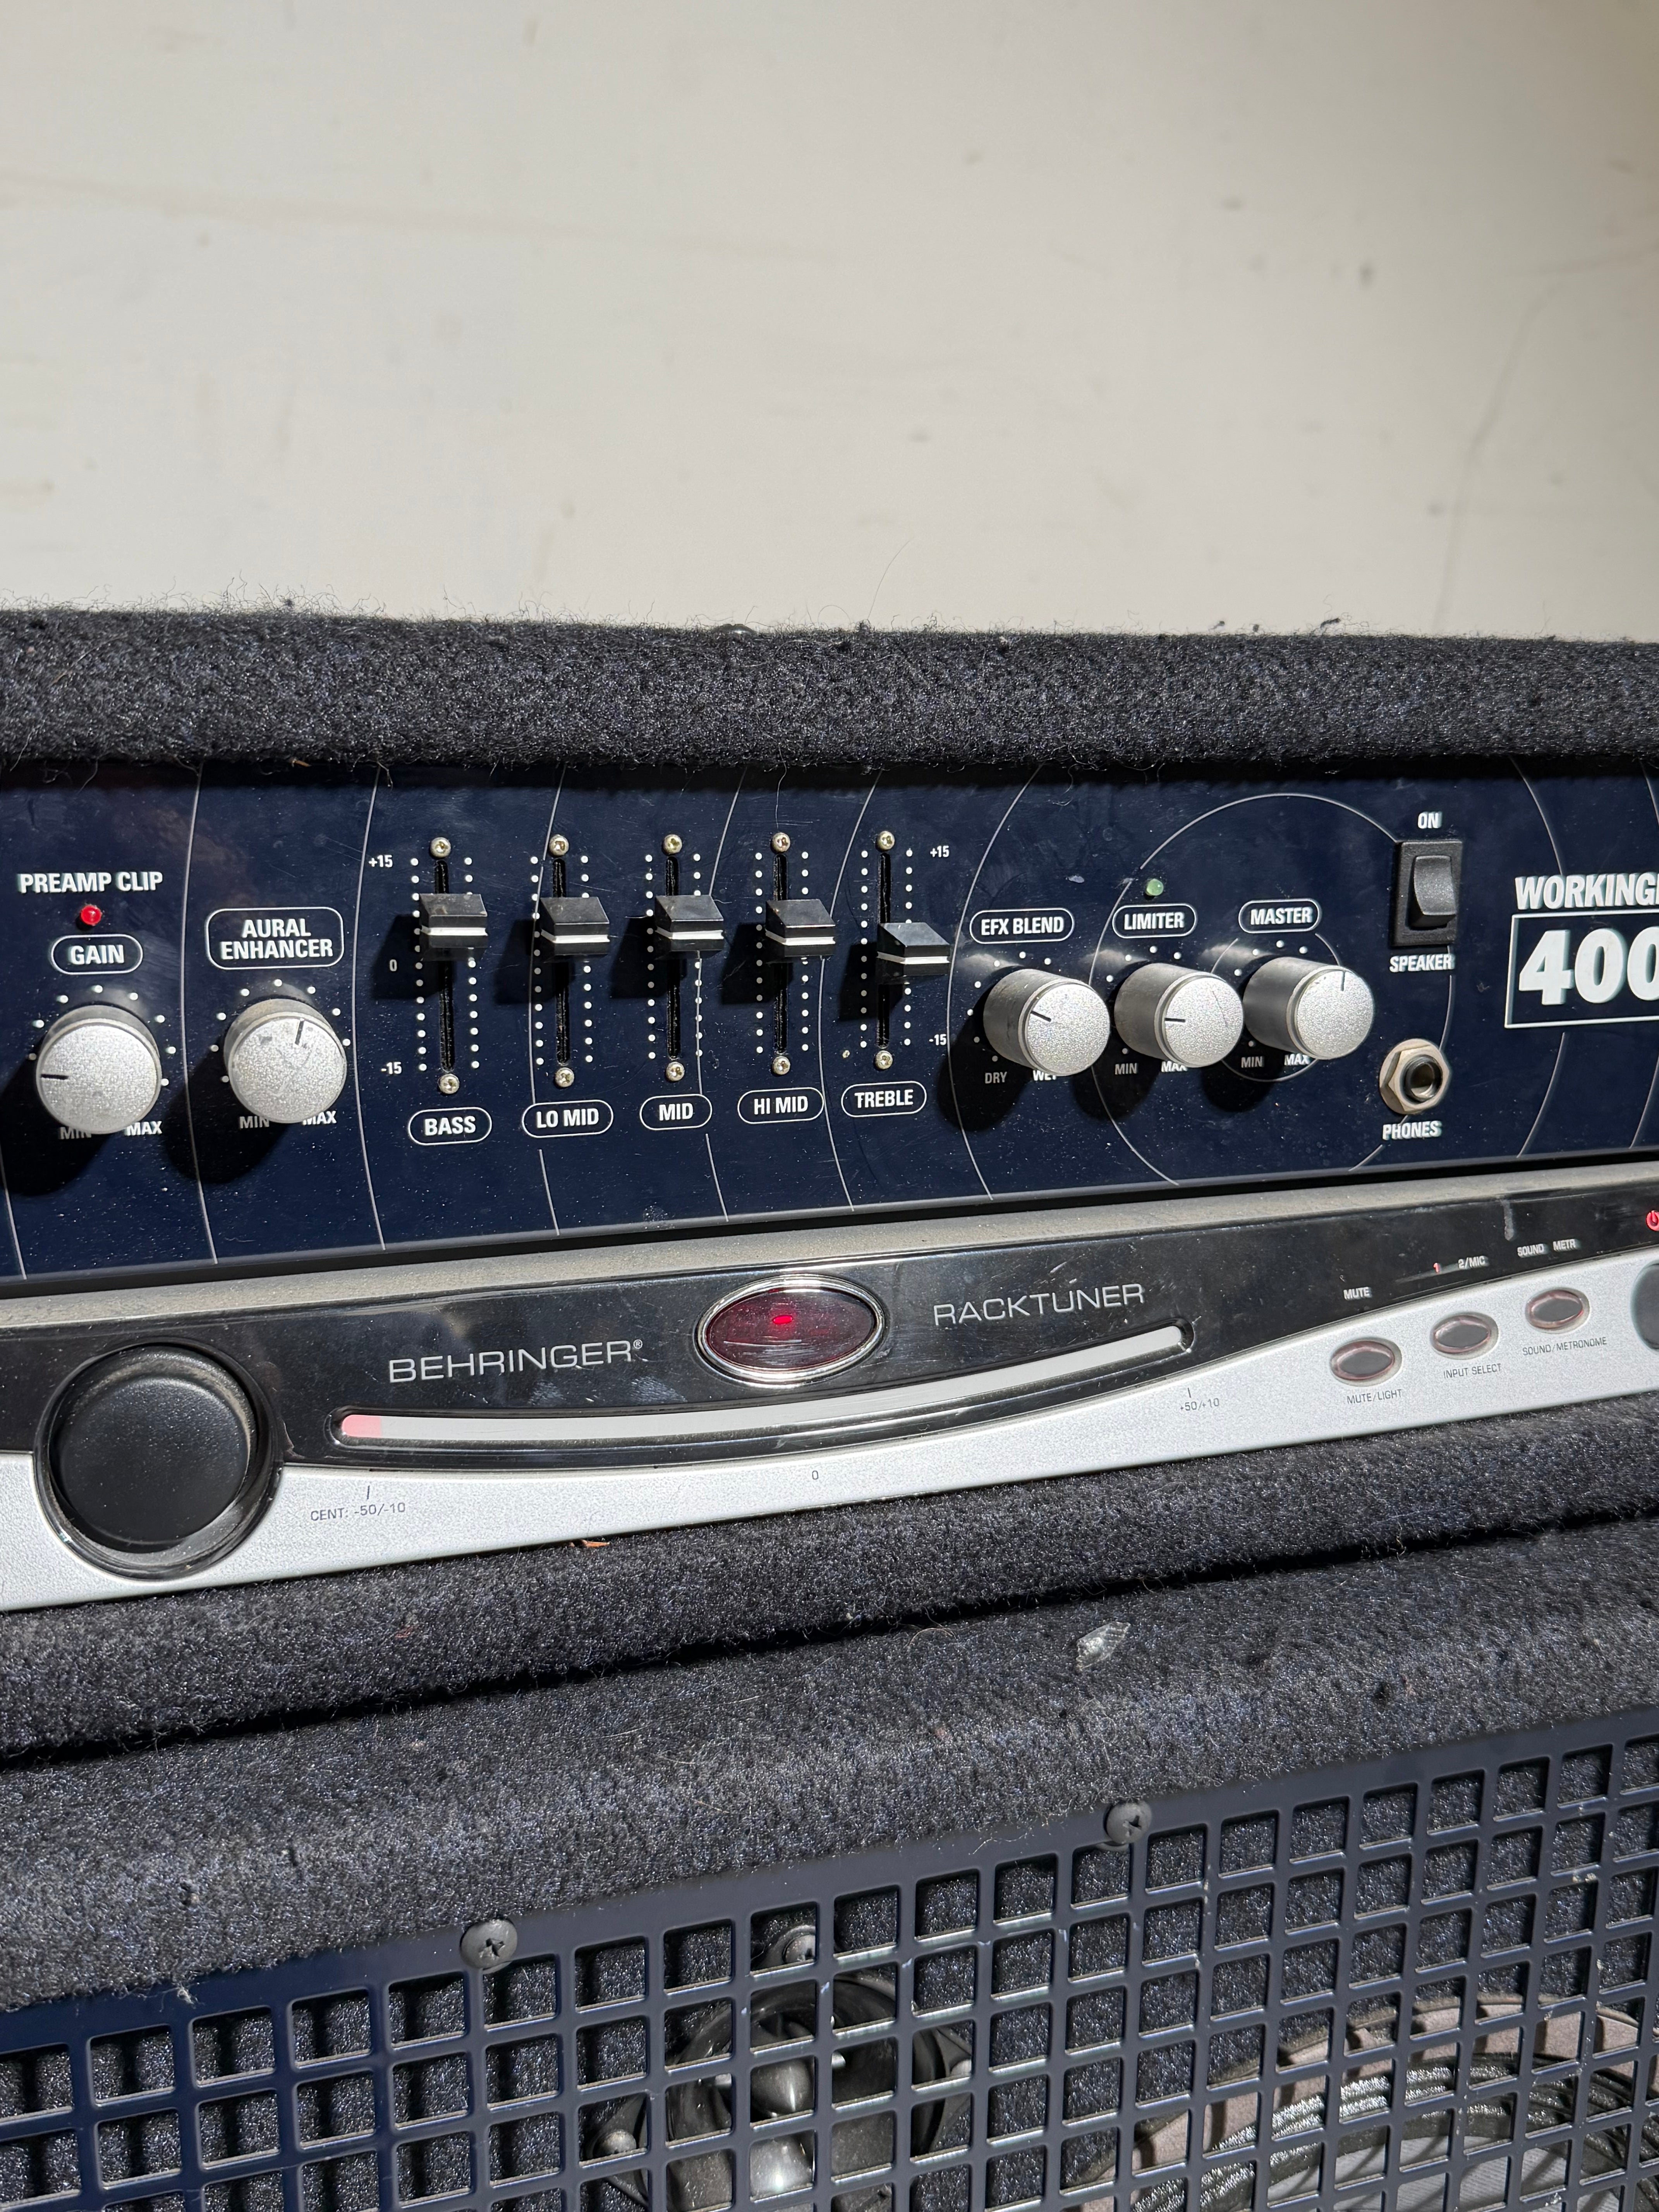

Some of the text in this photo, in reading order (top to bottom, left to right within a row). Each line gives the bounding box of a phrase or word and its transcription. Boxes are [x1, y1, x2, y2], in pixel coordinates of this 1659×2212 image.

[1418, 812, 1441, 829] ON
[930, 846, 949, 857] +15
[369, 855, 392, 868] +15
[19, 871, 163, 893] PREAMP CLIP
[1515, 872, 1659, 910] WORKING
[1124, 912, 1184, 929] LIMITER
[1251, 908, 1312, 925] MASTER
[242, 919, 311, 938] AURAL
[981, 916, 1064, 936] EFX BLEND
[69, 945, 125, 965] GAIN
[221, 939, 333, 960] ENHANCER
[389, 960, 397, 972] 0
[1390, 954, 1455, 972] SPEAKER
[929, 1034, 946, 1045] -15
[1241, 1056, 1264, 1068] MIN
[1284, 1053, 1310, 1066] MAX
[381, 1062, 402, 1074] -15
[1115, 1063, 1138, 1075] MIN
[985, 1072, 1007, 1084] DRY
[754, 1096, 808, 1115] HI MID
[854, 1089, 913, 1108] TREBLE
[536, 1108, 599, 1128] LO MID
[659, 1103, 694, 1121] MID
[124, 1121, 162, 1136] MAX
[239, 1116, 270, 1129] MIN
[424, 1116, 476, 1136] BASS
[1382, 1121, 1441, 1140] PHONES
[1517, 1243, 1545, 1258] SOUND
[1553, 1239, 1577, 1251] METR
[1433, 1263, 1440, 1273] 1
[1458, 1256, 1487, 1269] 2/MIC
[1343, 1286, 1371, 1300] MUTE
[934, 1283, 1144, 1326] RACKTUNER
[1523, 1337, 1607, 1356] SOUND/METRONOME
[1443, 1363, 1501, 1379] INPUT SELECT
[1180, 1398, 1219, 1411] +50/+10
[1347, 1389, 1402, 1405] MUTE/LIGHT
[812, 1470, 818, 1480] 0
[311, 1503, 405, 1521] CENT: -50/-10
